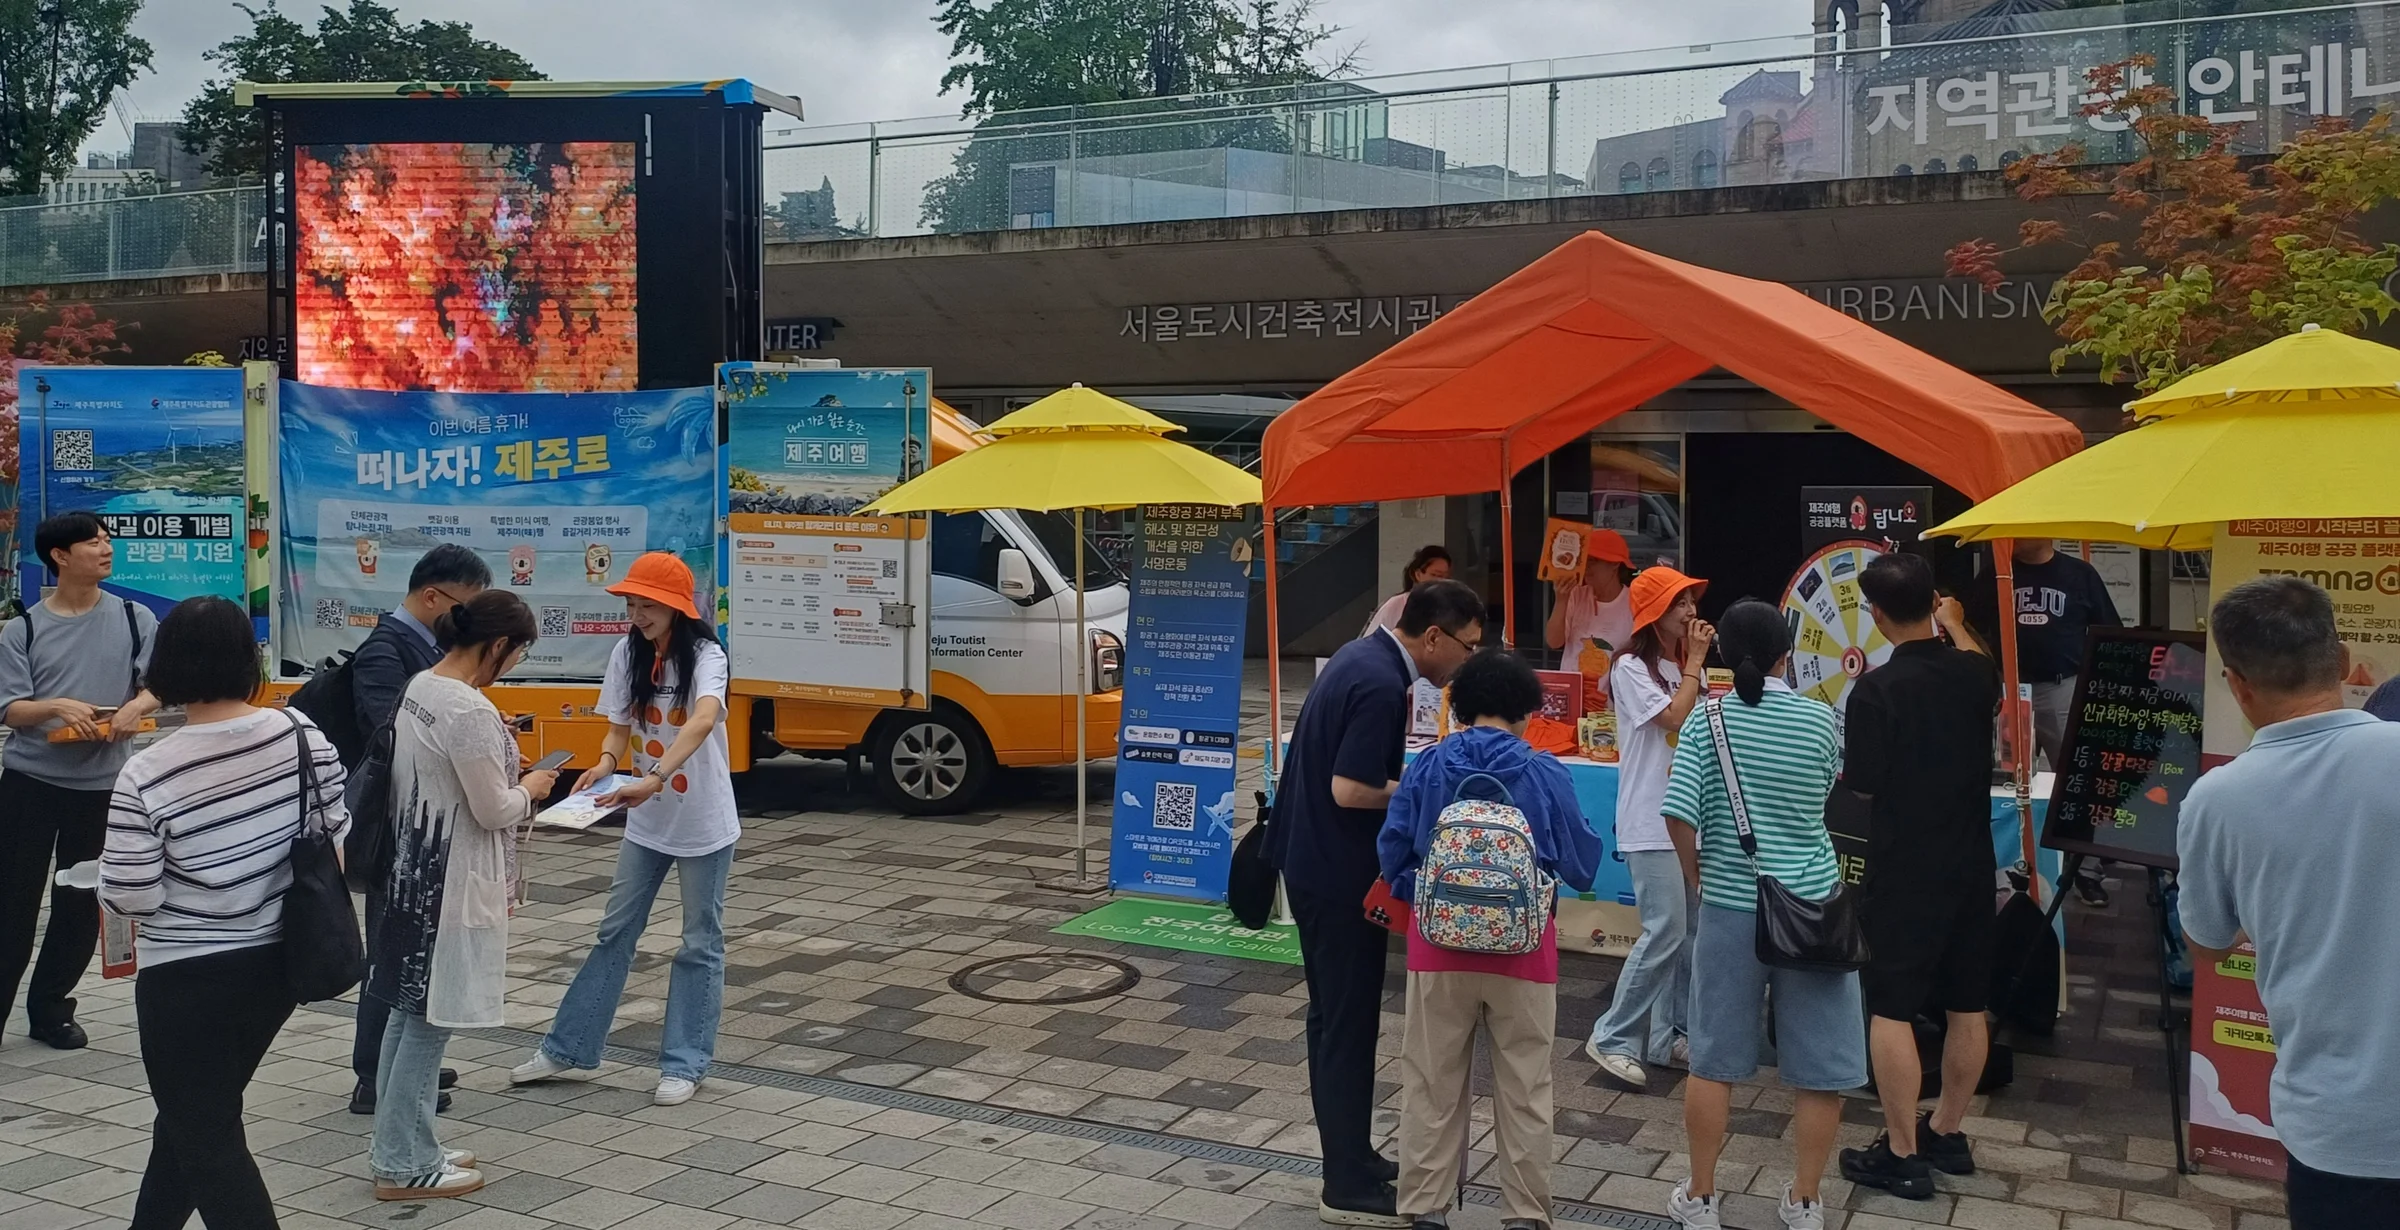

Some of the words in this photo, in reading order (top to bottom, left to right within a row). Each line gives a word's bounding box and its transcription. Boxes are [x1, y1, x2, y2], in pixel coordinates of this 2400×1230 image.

[1119, 296, 1441, 343] 서울도시건축전시관
[429, 420, 459, 436] 이번
[462, 418, 492, 434] 여름
[494, 413, 529, 432] 휴가!
[808, 415, 824, 428] 가고
[827, 412, 845, 429] 싶은
[846, 420, 866, 435] 순간
[787, 444, 866, 463] 제주여행
[356, 446, 482, 490] 떠나자!
[494, 435, 611, 482] 제주로
[351, 511, 388, 521] 단체관광객
[1146, 506, 1191, 519] 제주항공
[1194, 506, 1217, 519] 좌석
[1220, 507, 1243, 519] 부족
[1808, 502, 1841, 514] 제주여행
[1872, 501, 1917, 529] 탐나오
[143, 516, 183, 537] 이용
[189, 516, 230, 537] 개별
[444, 515, 459, 525] 이용
[490, 516, 514, 526] 특별한
[515, 516, 532, 526] 미식
[533, 516, 551, 526] 여행,
[605, 516, 620, 526] 행사
[1809, 516, 1847, 528] 공공플랫폼
[378, 524, 393, 534] 지원
[418, 525, 455, 536] 개별관광객
[456, 527, 472, 537] 지원
[562, 527, 592, 538] 즐길거리
[592, 527, 614, 537] 가득한
[615, 527, 631, 537] 제주
[1144, 522, 1167, 536] 해소
[1171, 523, 1182, 536] 및
[1185, 523, 1219, 537] 접근성
[2235, 520, 2310, 534] 제주여행의
[2315, 520, 2379, 535] 시작부터
[127, 542, 187, 563] 관광객
[194, 542, 233, 563] 지원
[1144, 540, 1177, 554] 개선을
[1180, 540, 1203, 554] 위한
[2258, 542, 2321, 557] 제주여행
[2325, 543, 2357, 557] 공공
[1142, 557, 1187, 571] 서명운동
[2342, 603, 2375, 614] 필요한
[574, 613, 601, 621] 제주여행
[603, 613, 618, 621] 공공
[573, 624, 595, 633] 탐나오
[931, 635, 947, 646] eju
[950, 636, 986, 645] Toutist
[2360, 632, 2371, 642] 할
[2373, 633, 2384, 642] 수
[930, 647, 985, 657] nformation
[987, 648, 1023, 657] Center
[2139, 687, 2159, 704] 지금
[1141, 915, 1291, 943] 전국여행관
[1085, 922, 1150, 935] Local
[1154, 929, 1224, 945] Travel
[1226, 939, 1303, 958] Gallery
[2216, 1006, 2248, 1018] 제주여행
[2249, 1011, 2269, 1022] 할인
